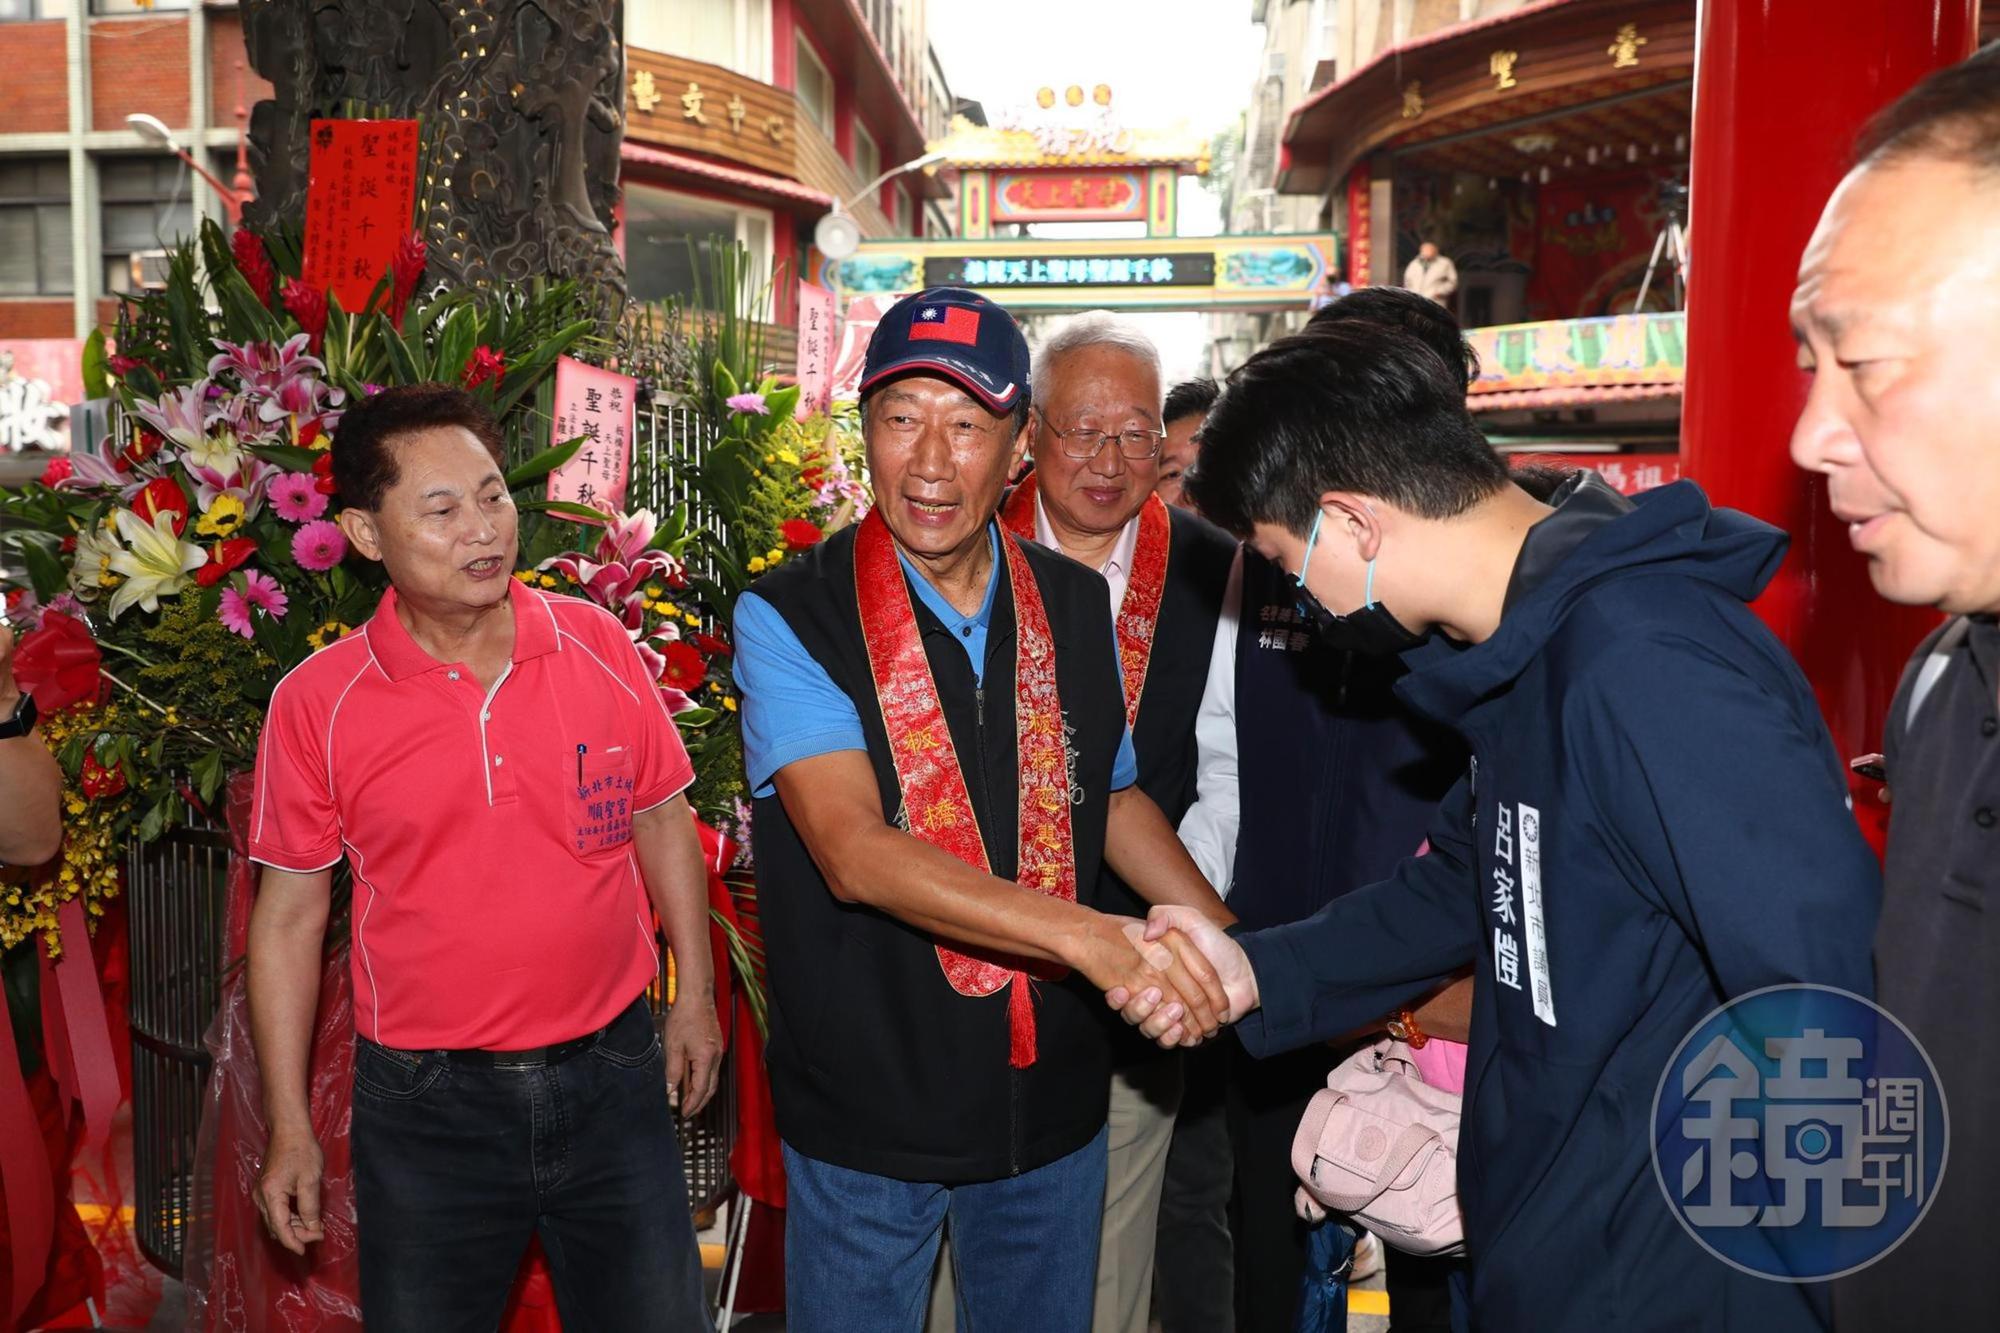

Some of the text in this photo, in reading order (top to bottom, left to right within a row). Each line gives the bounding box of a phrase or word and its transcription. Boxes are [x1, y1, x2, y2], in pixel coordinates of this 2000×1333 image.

[353, 133, 380, 281] 聖誕千秋
[577, 387, 602, 508] 聖誕千秋
[1597, 462, 1680, 492] 媽祖
[587, 797, 628, 821] 順聖宮
[1492, 802, 1522, 990] 呂家愷
